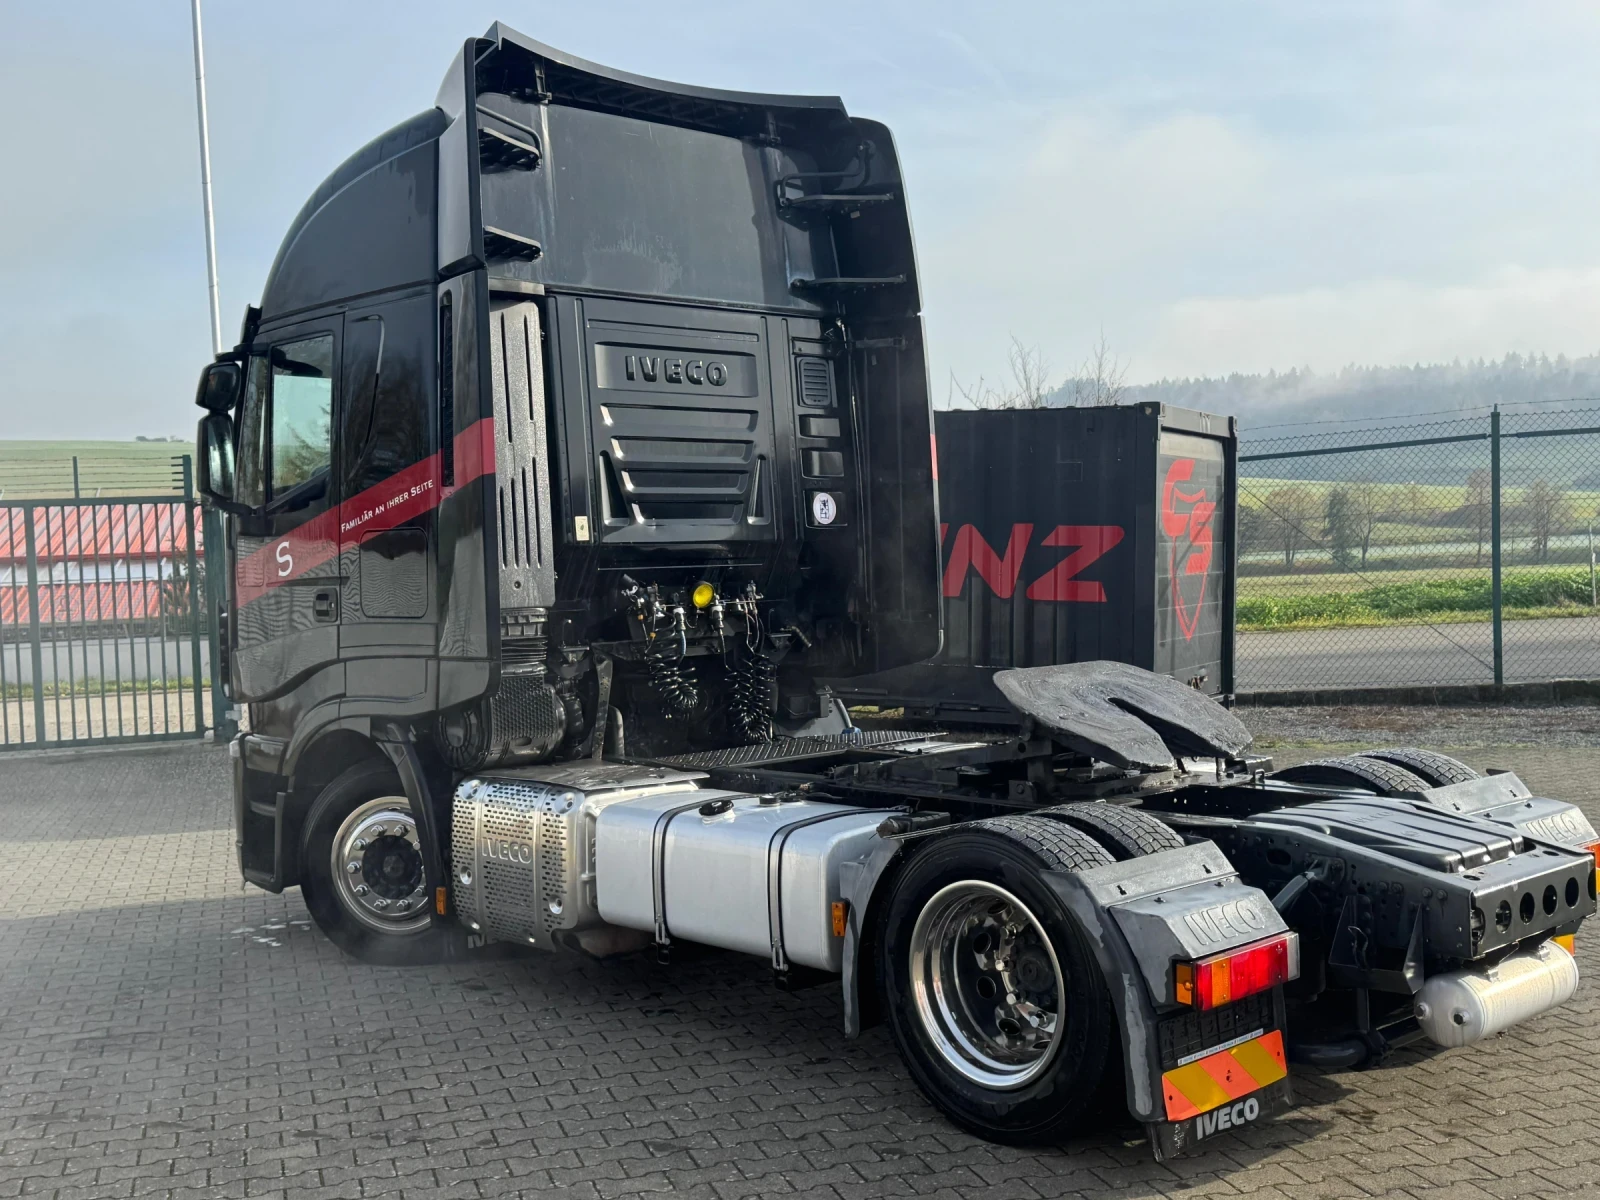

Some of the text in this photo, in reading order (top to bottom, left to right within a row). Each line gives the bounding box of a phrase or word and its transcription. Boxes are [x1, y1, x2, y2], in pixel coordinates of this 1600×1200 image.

[624, 355, 728, 387] IVECO
[375, 503, 385, 516] AN
[386, 492, 409, 510] IHRER
[410, 479, 434, 497] SEITE
[275, 541, 293, 577] S
[941, 523, 1125, 602] NZ
[481, 836, 532, 864] IVECO
[1183, 899, 1266, 946] IVECO
[1196, 1097, 1260, 1140] IVECO
